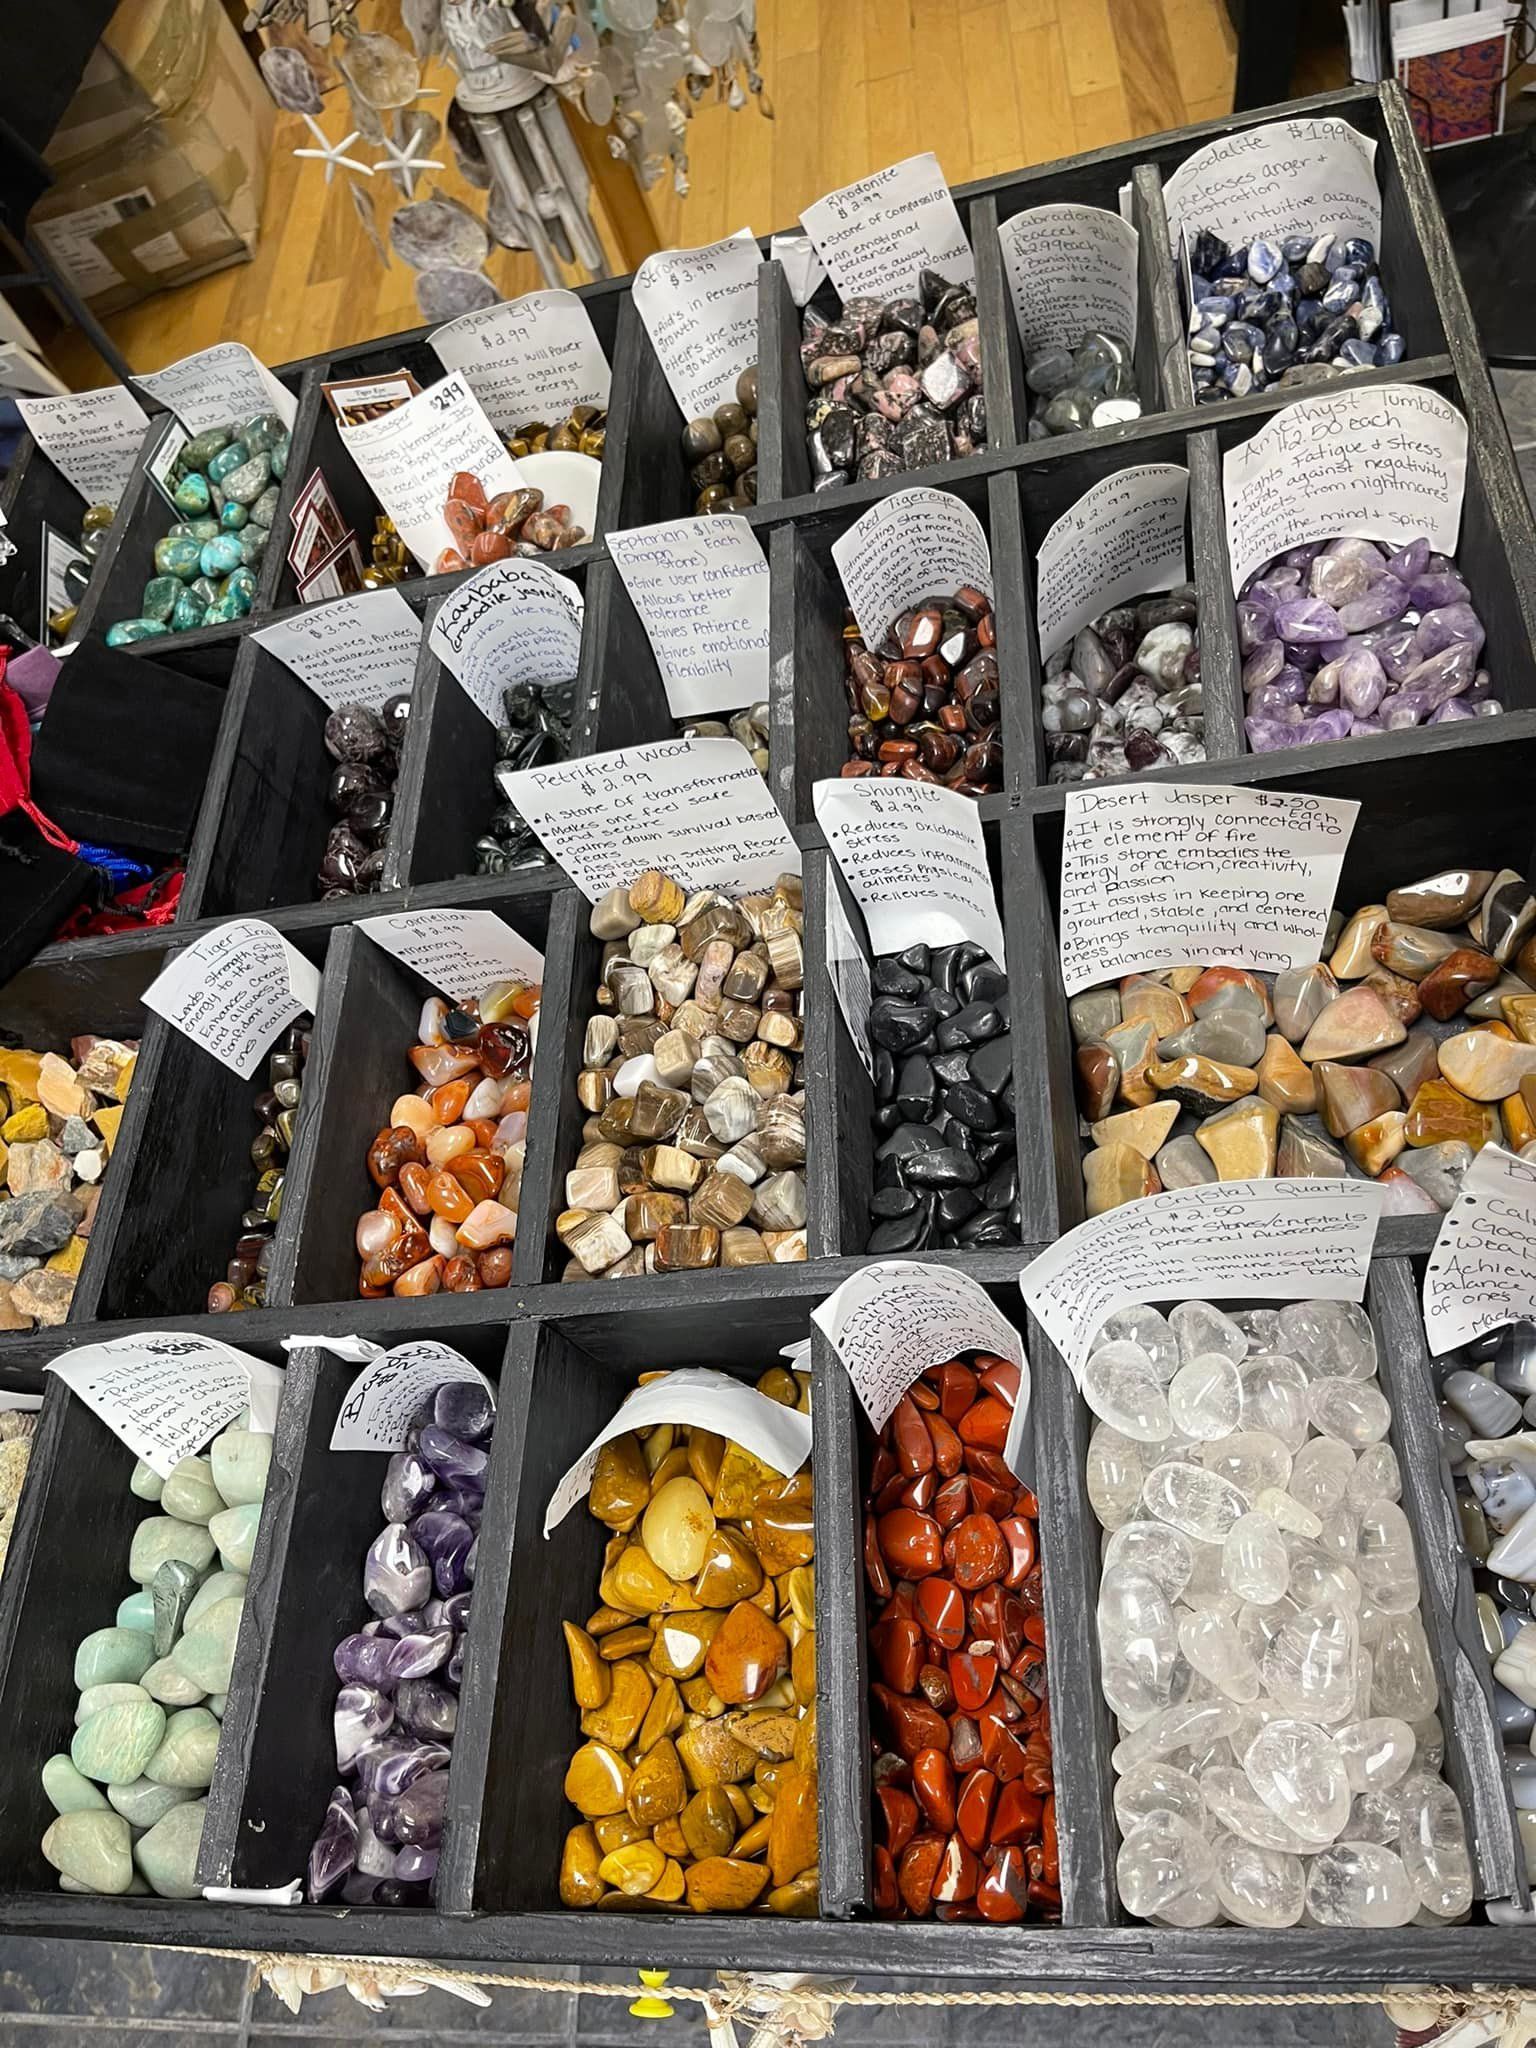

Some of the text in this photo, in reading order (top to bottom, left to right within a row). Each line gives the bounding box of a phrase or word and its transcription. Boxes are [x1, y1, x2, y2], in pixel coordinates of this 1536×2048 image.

[1263, 159, 1312, 177] anger
[827, 213, 881, 245] Stone of
[507, 299, 548, 322] Eye
[535, 378, 578, 394] energy
[1238, 388, 1457, 465] Amethyst Tumbled
[1349, 411, 1401, 430] each
[1287, 457, 1448, 489] against negativity
[1242, 468, 1283, 502] Fights
[1302, 476, 1448, 503] from nightmares
[1287, 507, 1368, 531] the mind
[608, 528, 688, 551] Septarian
[704, 536, 740, 548] Each
[703, 560, 770, 581] confidence
[641, 588, 733, 606] Allows better
[287, 602, 360, 632] Garnet
[646, 604, 710, 619] tolerance
[703, 630, 770, 653] emotional
[530, 742, 693, 790] Petrified Wood
[854, 784, 941, 802] Shungite
[1076, 790, 1319, 814] Desert Jasper $2.50
[551, 802, 679, 836] Makes one feel
[622, 831, 662, 845] down
[736, 808, 780, 823] based
[1108, 813, 1342, 834] is strongly connected to
[1289, 808, 1338, 824] Each
[556, 832, 593, 844] and
[840, 822, 908, 836] Reduces
[1065, 829, 1258, 851] the element of fire
[583, 852, 676, 874] Assists in
[687, 856, 725, 870] with
[852, 849, 916, 864] Reduces
[1117, 846, 1291, 862] stone embodies the
[858, 864, 913, 877] Eases
[1130, 860, 1148, 873] of
[862, 874, 930, 888] ailments
[1063, 883, 1097, 898] and
[1108, 887, 1305, 907] assists in keeping one
[1256, 903, 1327, 922] centered
[1073, 919, 1278, 951] Brings tranquility and
[187, 934, 234, 960] Tiger
[1064, 947, 1108, 966] eness
[1101, 947, 1293, 969] balances yang
[217, 981, 232, 991] to
[232, 964, 253, 978] the
[258, 999, 302, 1034] reality
[1154, 1185, 1256, 1209] Crystal
[1275, 1182, 1373, 1197] Quartz
[1432, 1277, 1525, 1295] balance
[1431, 1296, 1452, 1316] of
[180, 1380, 209, 1395] and
